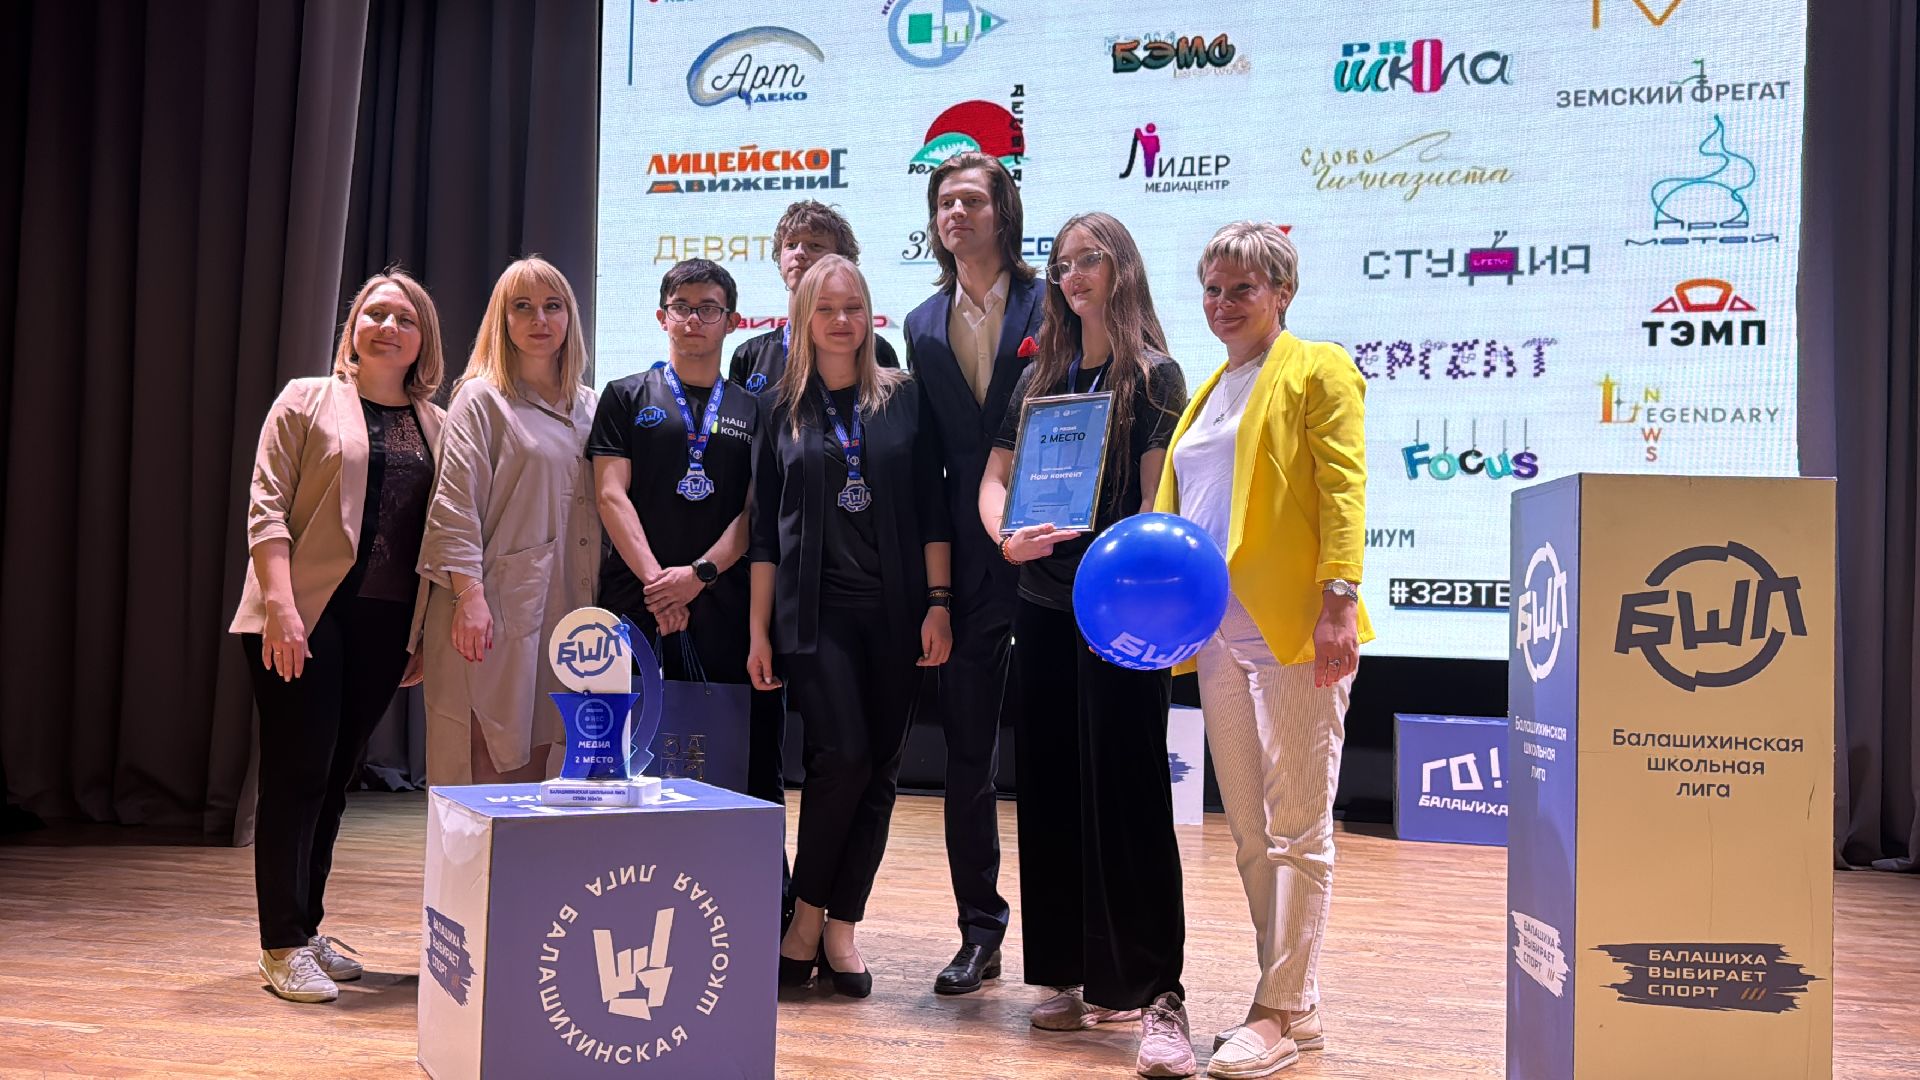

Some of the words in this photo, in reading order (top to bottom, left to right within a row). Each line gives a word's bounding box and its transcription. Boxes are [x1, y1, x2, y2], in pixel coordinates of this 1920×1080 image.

[753, 91, 808, 103] ДЕКО
[1556, 84, 1683, 108] ЗЕМСКИЙ
[1691, 79, 1791, 103] ФРЕГАТ
[1145, 180, 1230, 193] МЕДИАЦЕНТР
[1641, 319, 1766, 347] ТЭМП
[721, 416, 747, 428] НАШ
[1040, 434, 1047, 444] 2
[1050, 432, 1086, 443] МЕСТО
[1515, 715, 1567, 742] Балашихинская
[577, 740, 611, 749] МЕДИА
[1613, 729, 1804, 752] Балашихинская
[575, 756, 580, 764] 2
[582, 756, 614, 764] МЕСТО
[1647, 757, 1765, 775] школьная
[1676, 782, 1730, 797] лига
[1418, 794, 1508, 817] БАЛАШИХА
[584, 864, 657, 897] ЛИГА
[673, 872, 730, 1016] ШКОЛЬНАЯ
[1649, 949, 1768, 966] БАЛАШИХА
[1648, 967, 1767, 983] ВЫБИРАЕТ
[538, 903, 689, 1065] БАЛАШИХИНСКАЯ
[1647, 984, 1719, 999] СПОРТ
